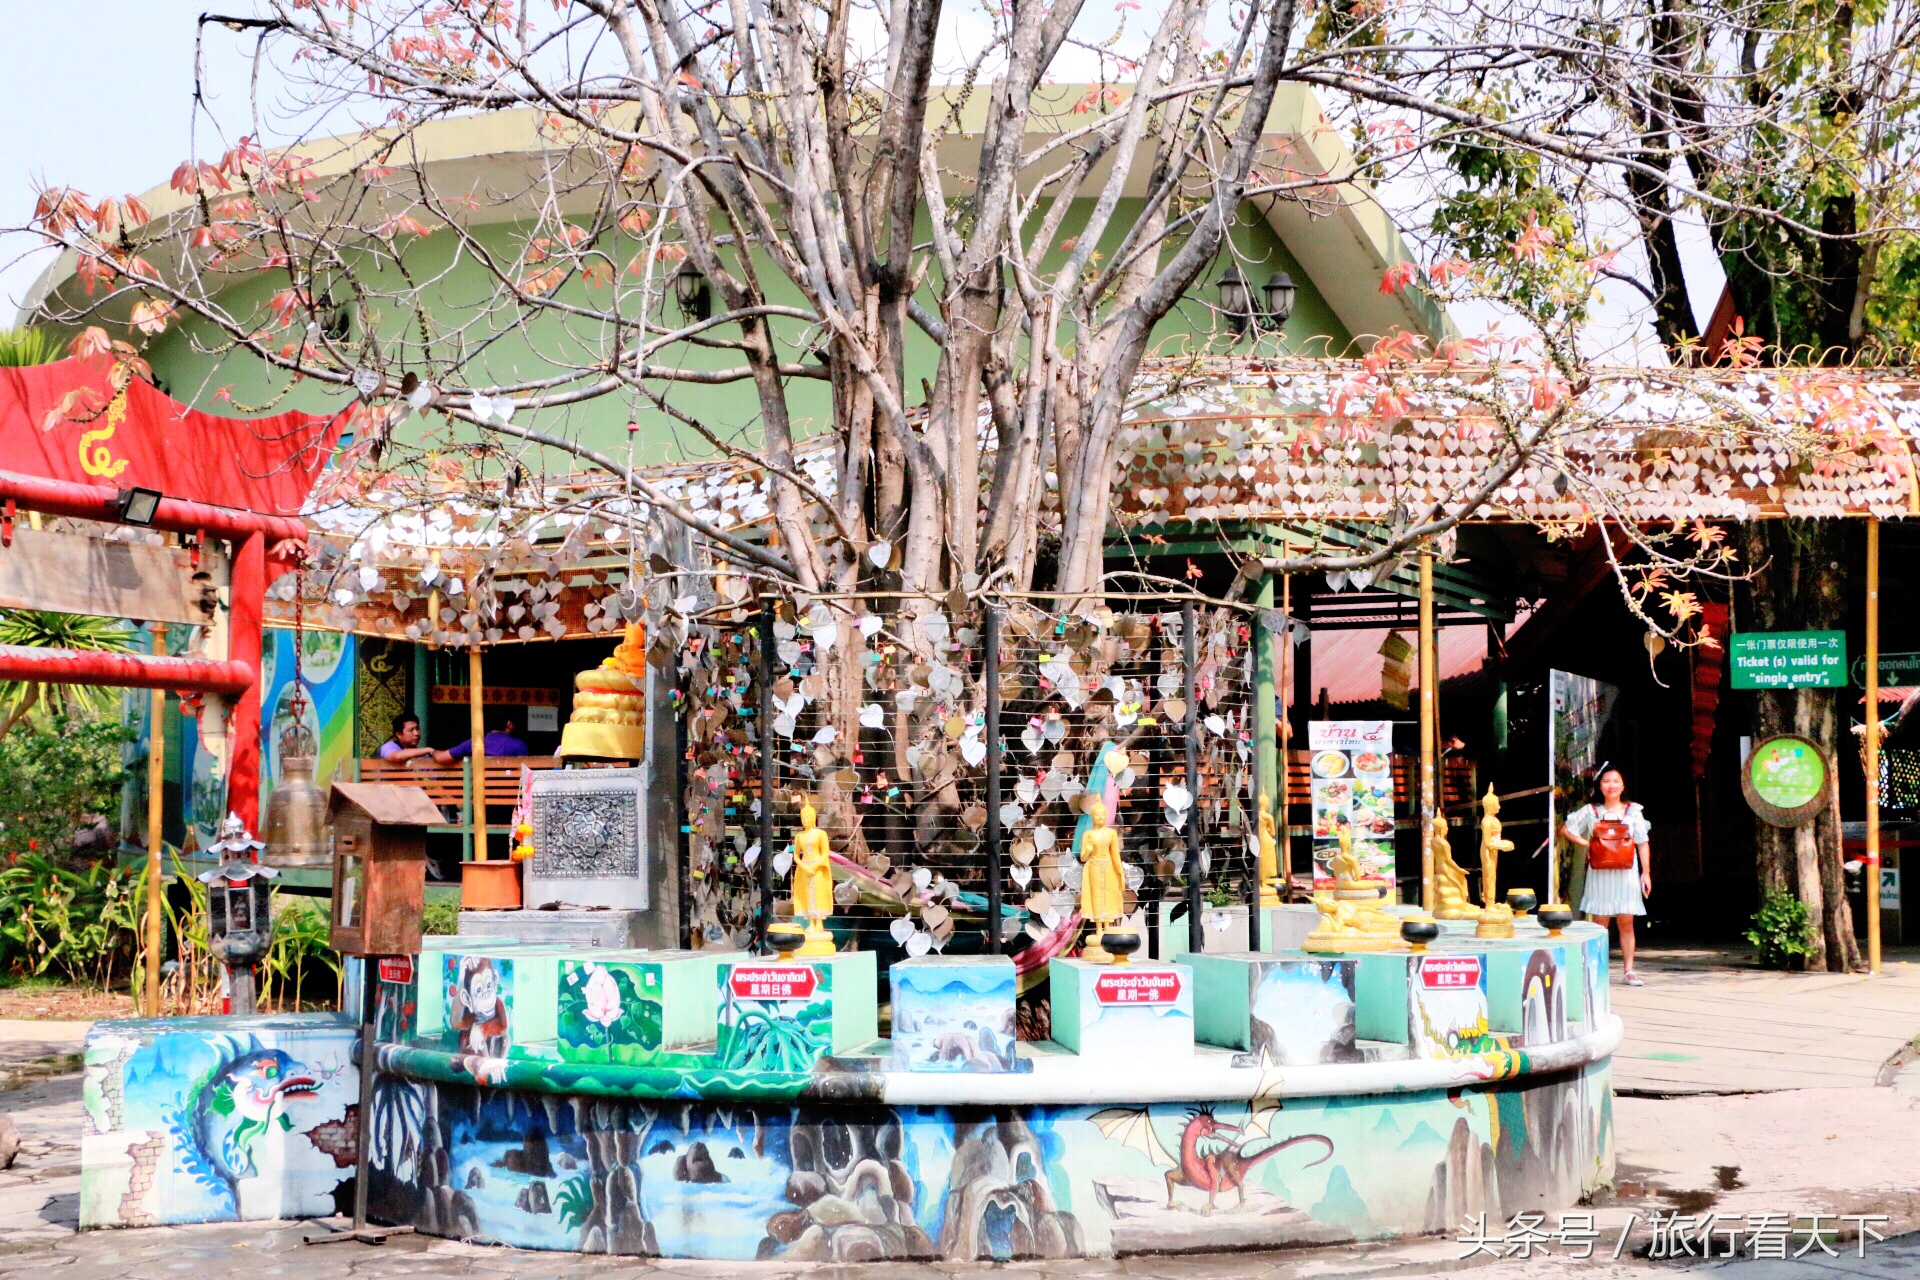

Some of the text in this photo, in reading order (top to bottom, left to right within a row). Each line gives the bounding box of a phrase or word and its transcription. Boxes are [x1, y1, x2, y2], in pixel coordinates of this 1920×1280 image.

[1736, 637, 1839, 650] 一张门票仅限使用一次
[1737, 654, 1839, 668] Ticket (s) valid for
[750, 984, 792, 995] 星期日佛
[1117, 989, 1159, 1001] 星期一佛
